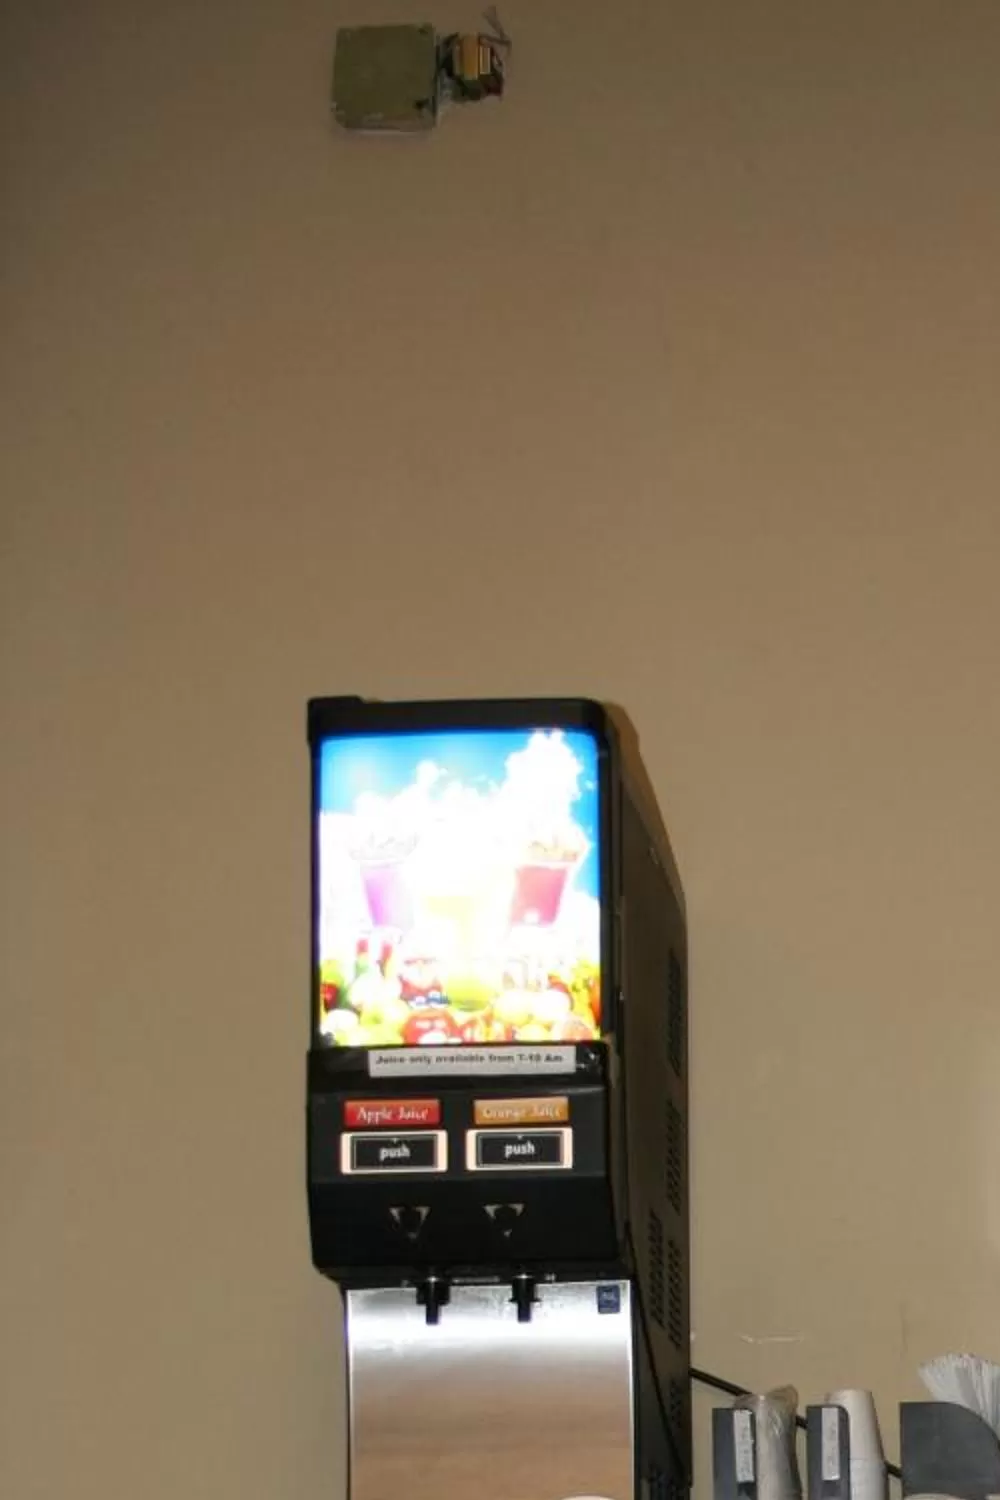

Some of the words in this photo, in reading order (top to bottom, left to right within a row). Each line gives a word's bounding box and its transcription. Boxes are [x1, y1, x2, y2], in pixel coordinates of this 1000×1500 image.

[376, 1055, 406, 1065] Juice
[410, 1055, 431, 1065] only
[435, 1053, 485, 1064] available
[488, 1053, 514, 1063] from
[357, 1106, 393, 1125] Apple
[397, 1106, 429, 1121] Juice
[482, 1105, 526, 1122] Orange
[530, 1103, 561, 1118] Juice
[379, 1143, 411, 1161] push
[504, 1140, 536, 1158] push
